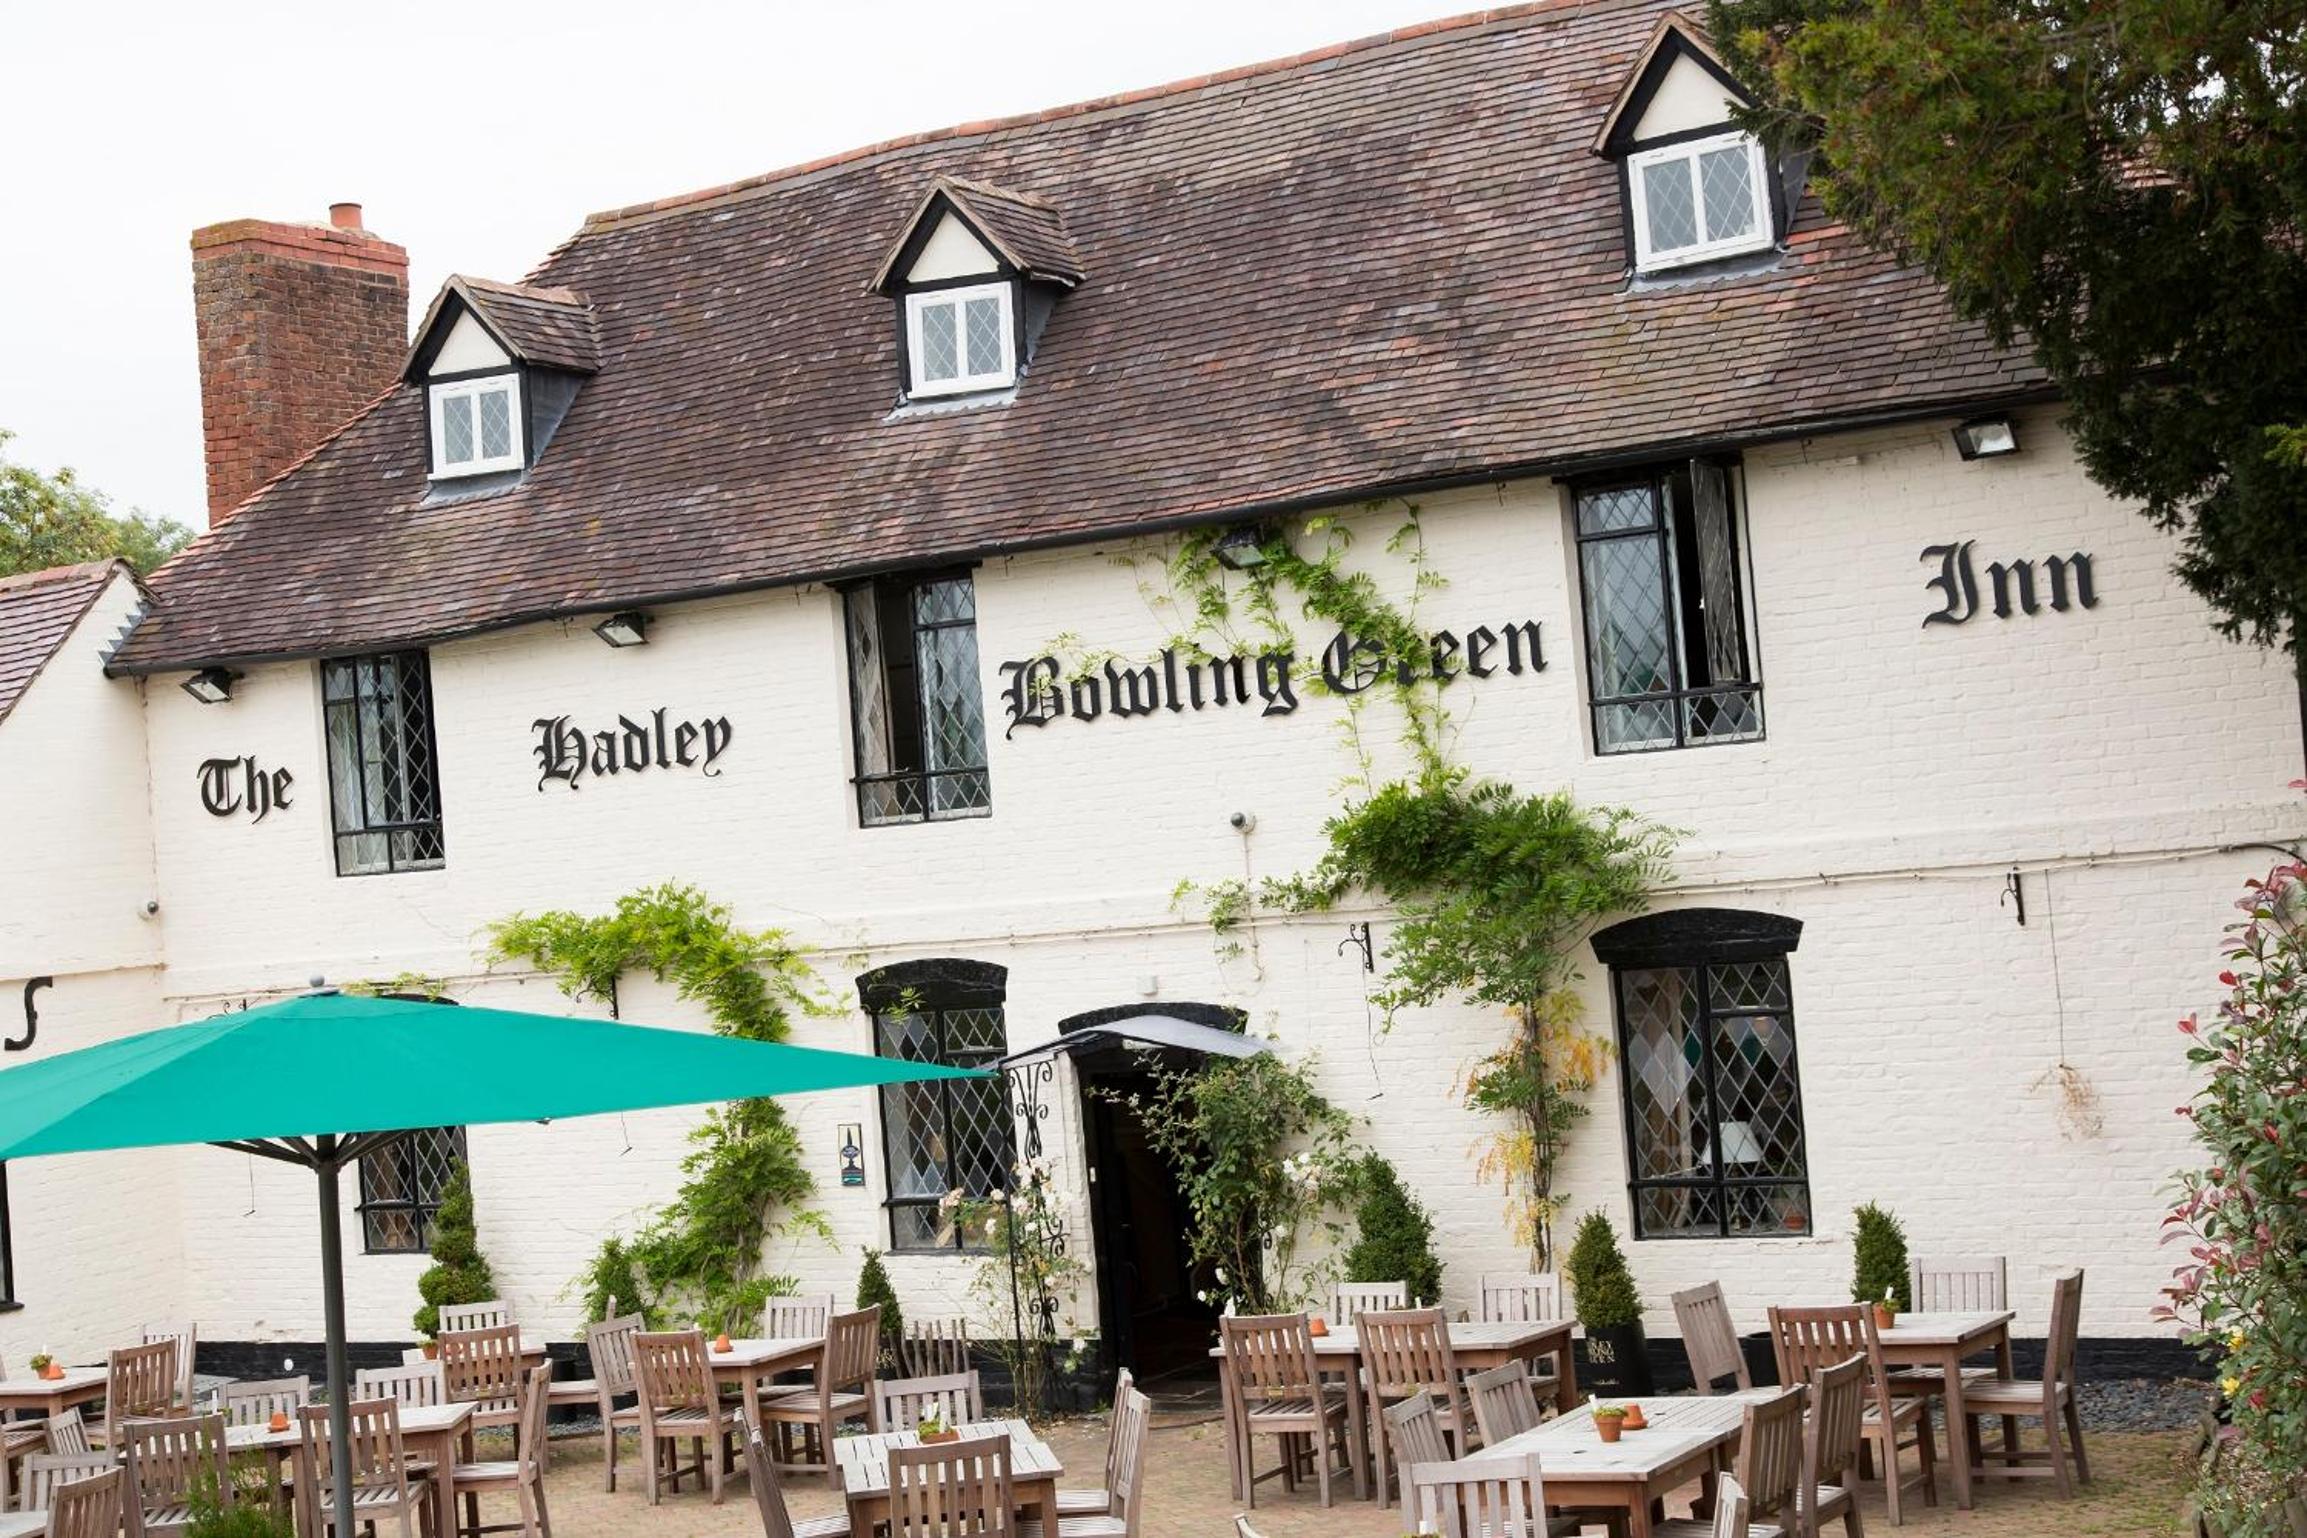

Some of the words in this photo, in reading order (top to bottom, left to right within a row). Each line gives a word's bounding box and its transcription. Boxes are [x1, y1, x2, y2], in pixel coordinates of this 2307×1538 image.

[196, 754, 294, 825] The
[531, 706, 731, 793] Hadley
[999, 642, 1299, 740] Bowling
[1919, 538, 2099, 630] Inn
